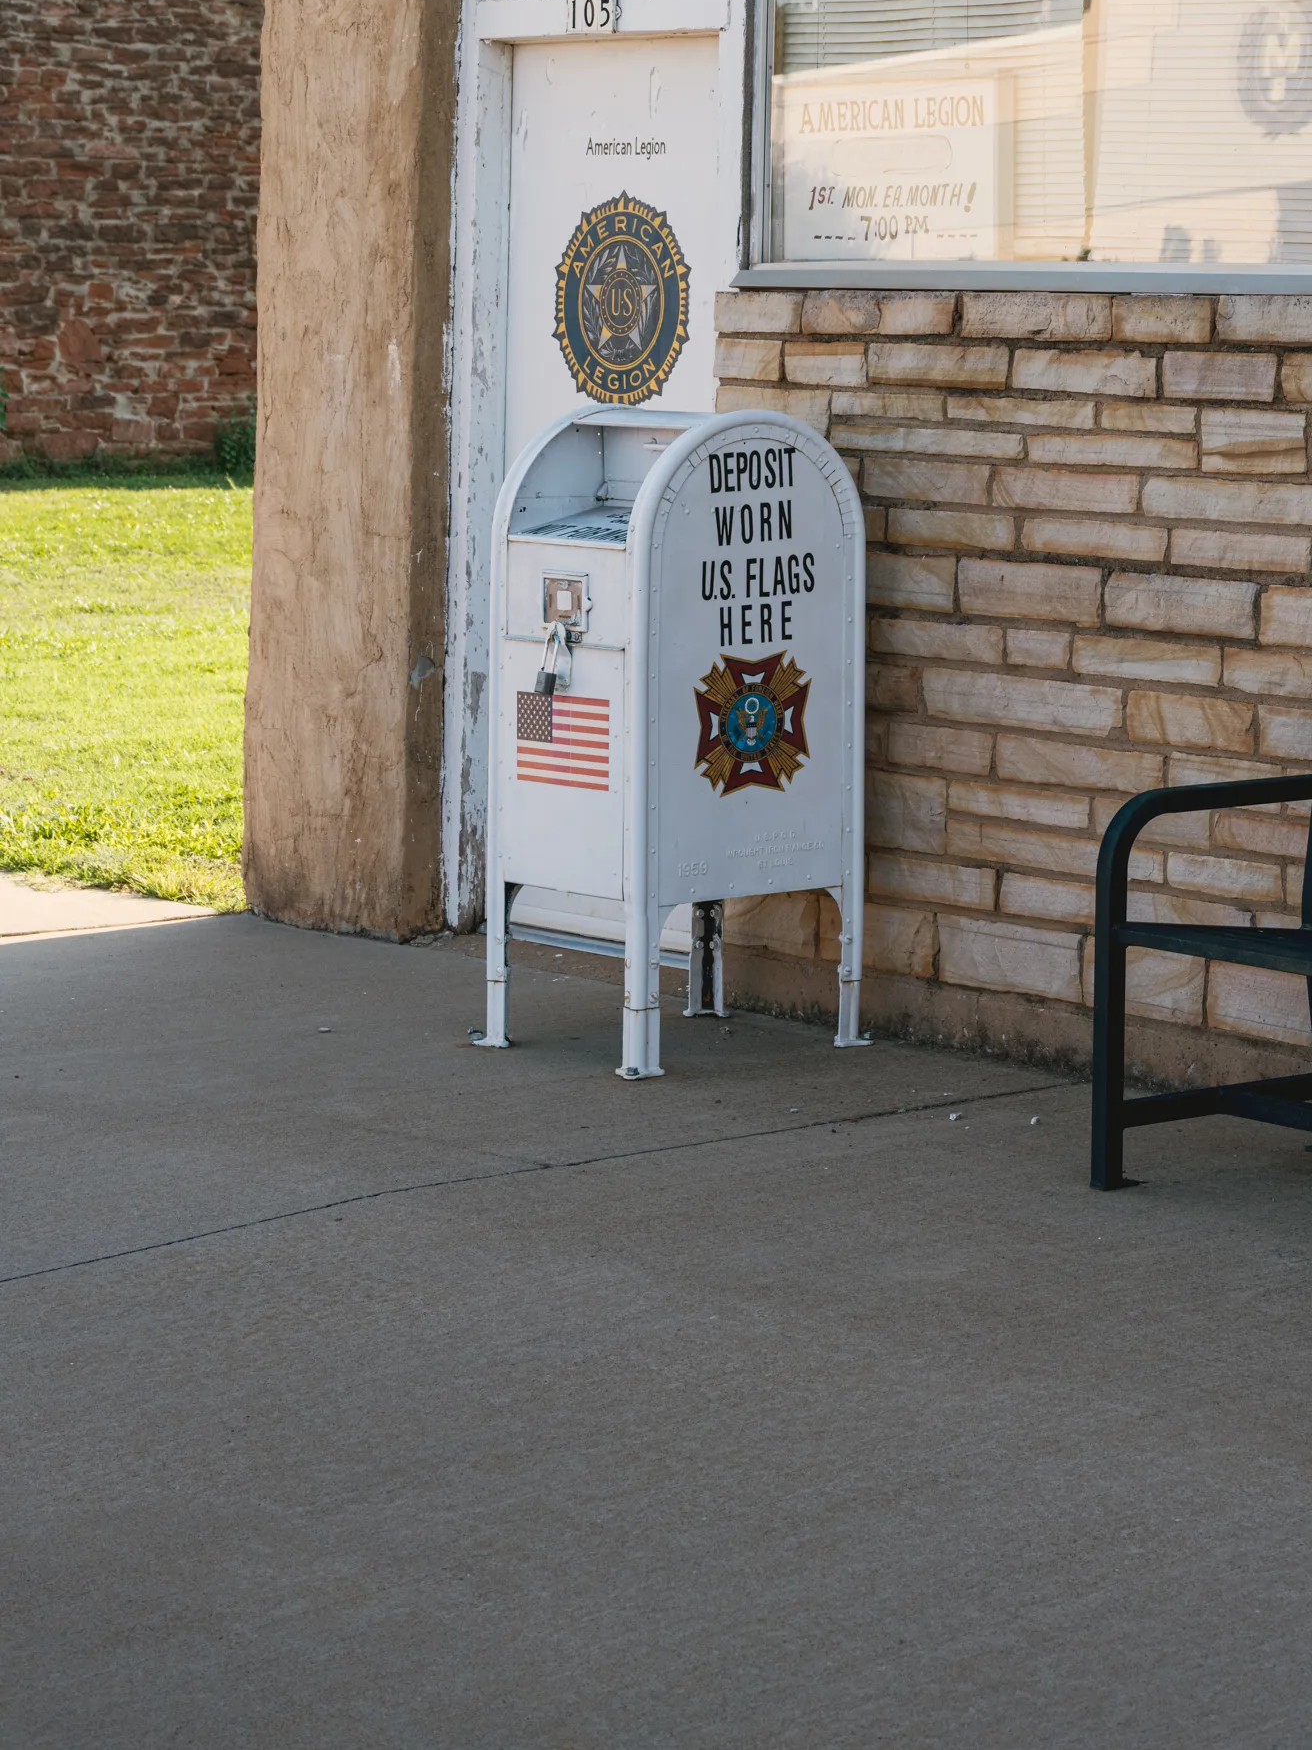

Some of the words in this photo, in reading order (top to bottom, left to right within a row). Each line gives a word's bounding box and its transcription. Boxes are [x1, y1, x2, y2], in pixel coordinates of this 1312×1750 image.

[798, 98, 905, 134] AMERICAN
[913, 94, 985, 129] LEGION
[586, 136, 632, 156] American
[635, 136, 666, 161] Legion
[573, 215, 675, 280] AMERICAN
[860, 214, 899, 242] 7:00
[904, 215, 930, 235] PM
[582, 357, 658, 391] LEGION
[709, 447, 796, 494] DEPOSIT
[715, 500, 792, 547] WORN
[702, 560, 736, 601] U.S.
[746, 552, 815, 598] FLAGS
[720, 600, 793, 647] HERE
[677, 861, 709, 878] 1959
